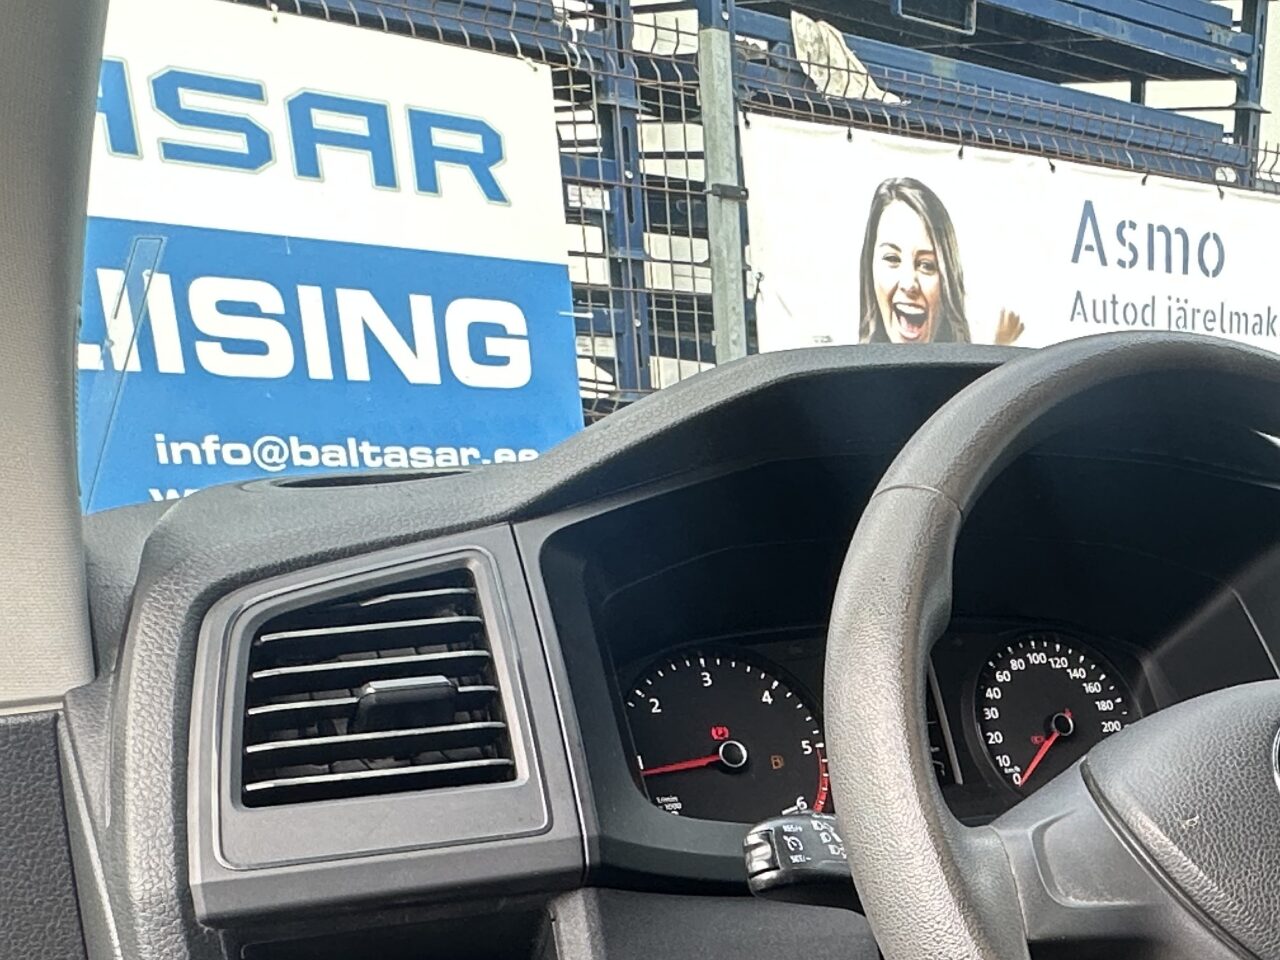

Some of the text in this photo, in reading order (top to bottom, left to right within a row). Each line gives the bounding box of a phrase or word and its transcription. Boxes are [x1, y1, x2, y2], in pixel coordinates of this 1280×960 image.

[1071, 199, 1226, 278] Asmo
[1070, 289, 1156, 328] Autod
[154, 433, 540, 471] info@baltasar.ee
[1010, 658, 1026, 671] 80
[1026, 651, 1048, 665] 100
[1048, 656, 1069, 669] 120
[701, 671, 713, 687] 3
[995, 670, 1012, 683] 60
[1066, 667, 1087, 680] 140
[985, 686, 1002, 700] 40
[1082, 681, 1102, 694] 160
[761, 690, 774, 705] 4
[649, 698, 662, 713] 2
[1095, 700, 1114, 712] 180
[983, 706, 1000, 720] 30
[1101, 720, 1121, 733] 200
[986, 730, 1004, 745] 20
[801, 740, 813, 755] 5
[996, 754, 1011, 768] 10
[1012, 772, 1022, 786] 0
[796, 796, 808, 811] 6
